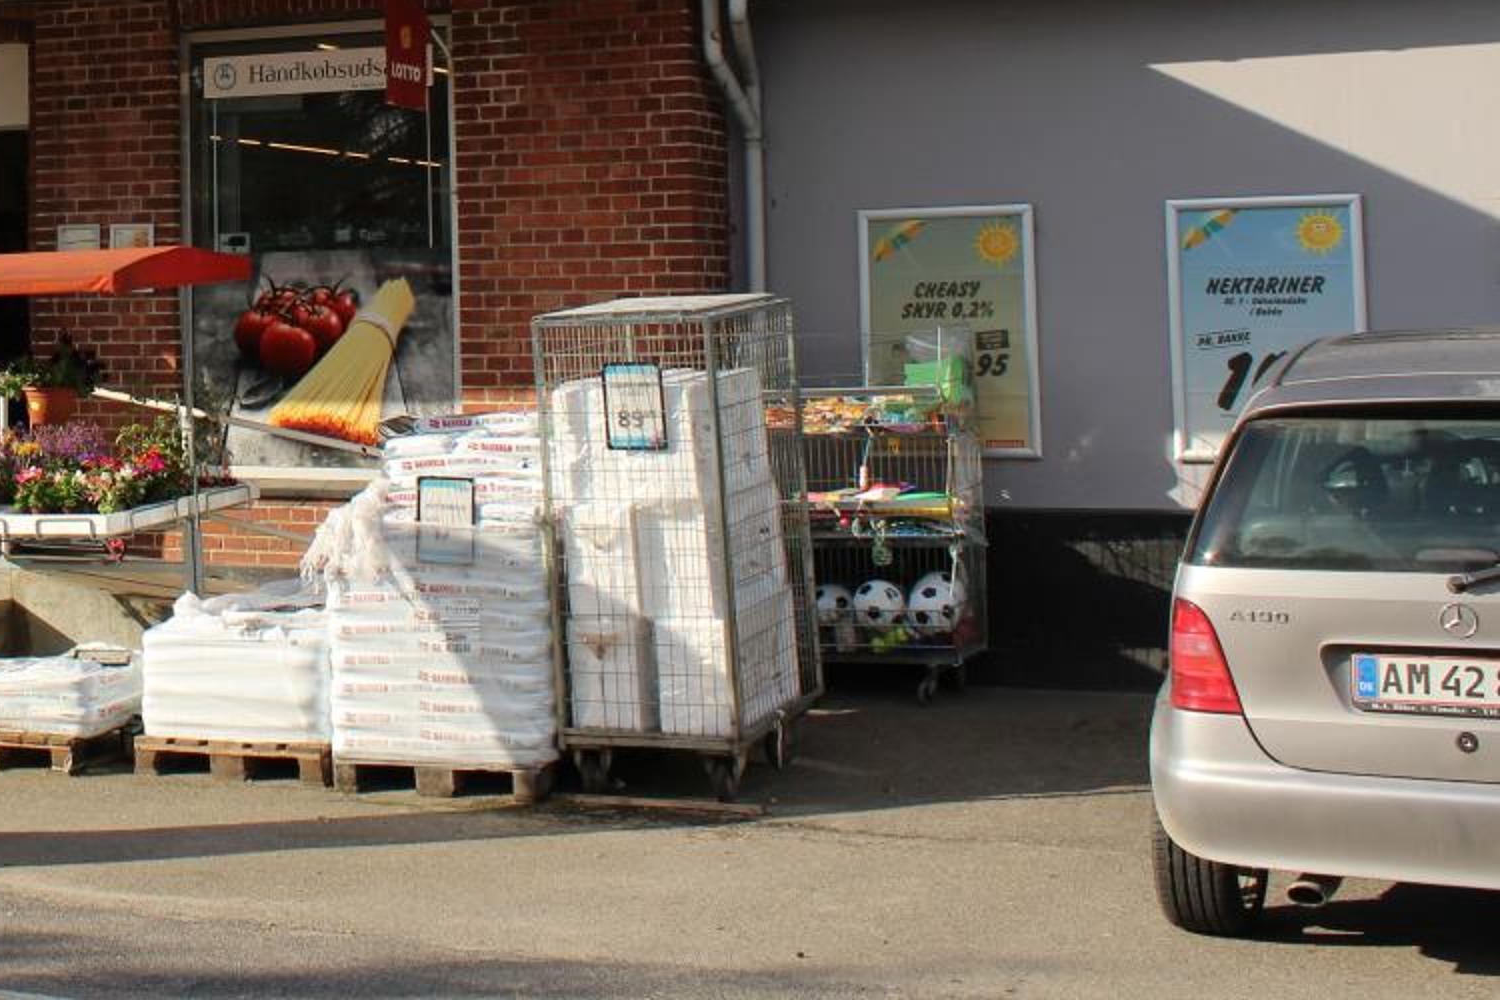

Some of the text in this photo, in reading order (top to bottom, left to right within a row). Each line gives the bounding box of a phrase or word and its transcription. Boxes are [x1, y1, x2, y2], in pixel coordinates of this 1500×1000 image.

[391, 62, 421, 83] LOTTO
[913, 280, 982, 300] CHEASY
[1205, 276, 1326, 296] NEKTARINER
[901, 302, 948, 320] SKYR
[1382, 662, 1431, 695] AM
[1441, 665, 1485, 698] 42
